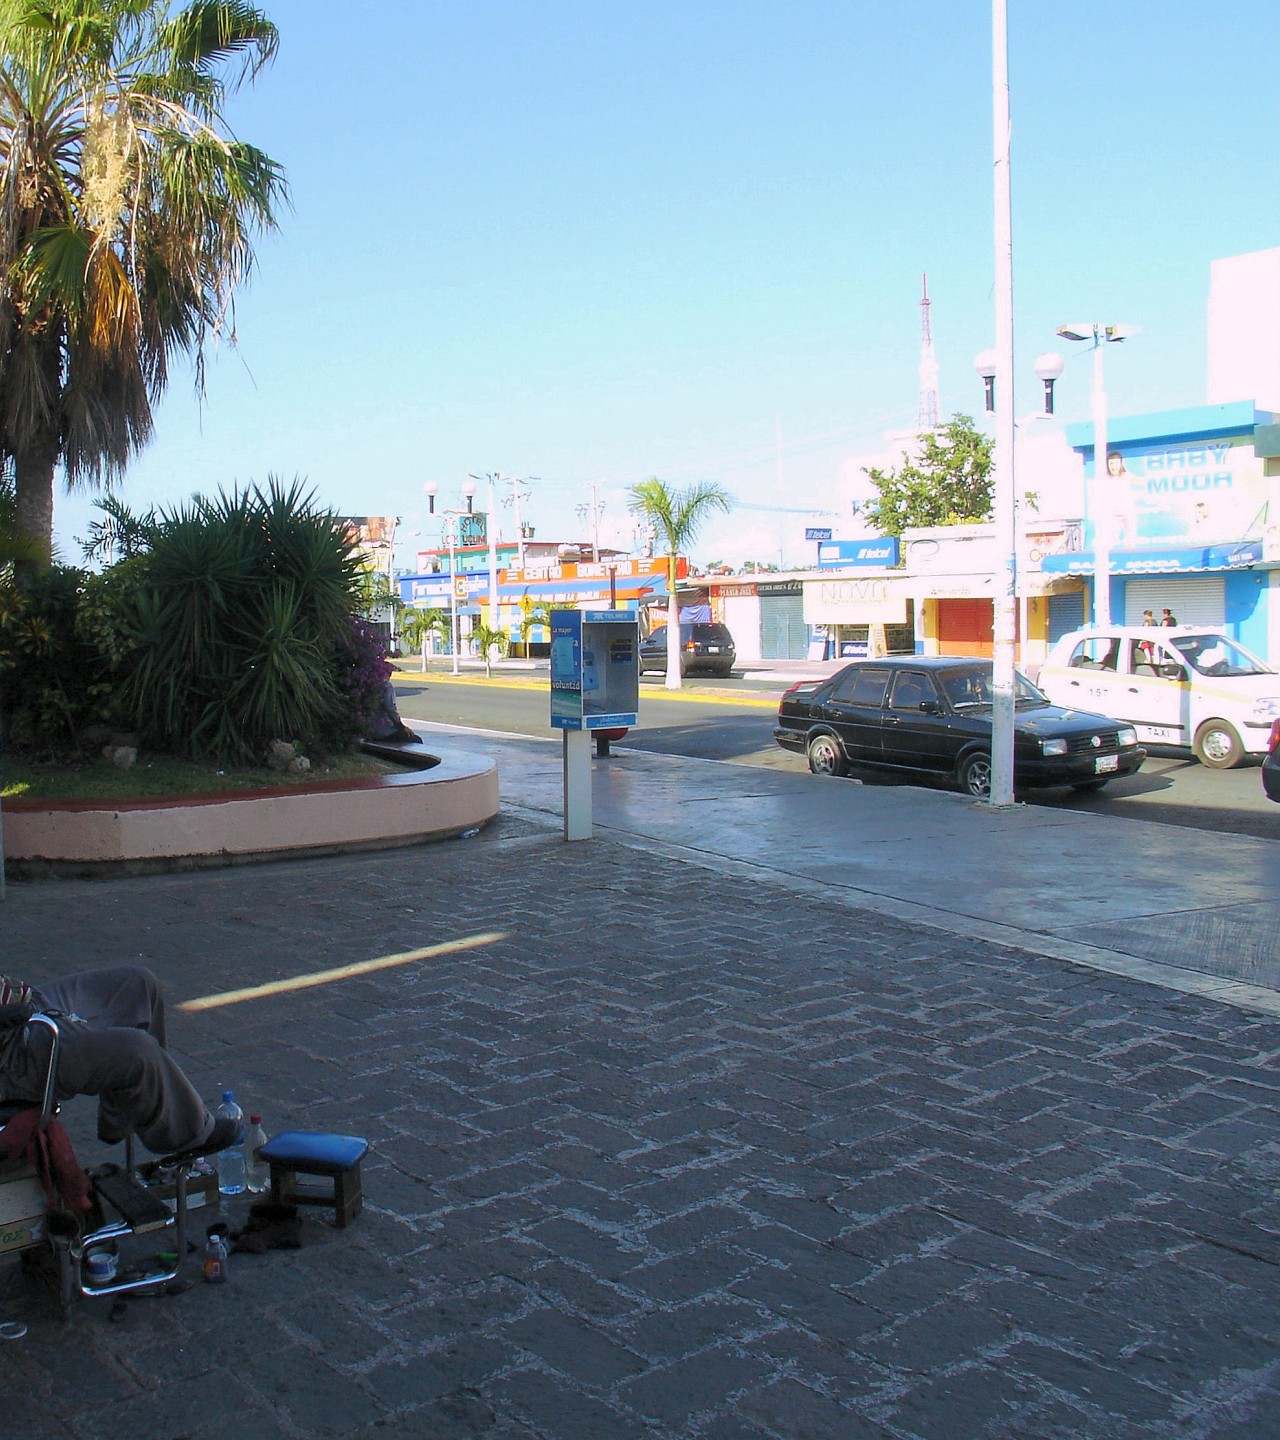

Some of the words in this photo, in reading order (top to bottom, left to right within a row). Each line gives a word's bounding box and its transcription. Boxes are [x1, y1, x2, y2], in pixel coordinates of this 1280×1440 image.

[461, 516, 484, 532] HOTEL
[813, 530, 832, 539] telcel
[865, 547, 891, 559] telcel
[1126, 560, 1181, 569] MODA
[1147, 727, 1170, 737] TAXI
